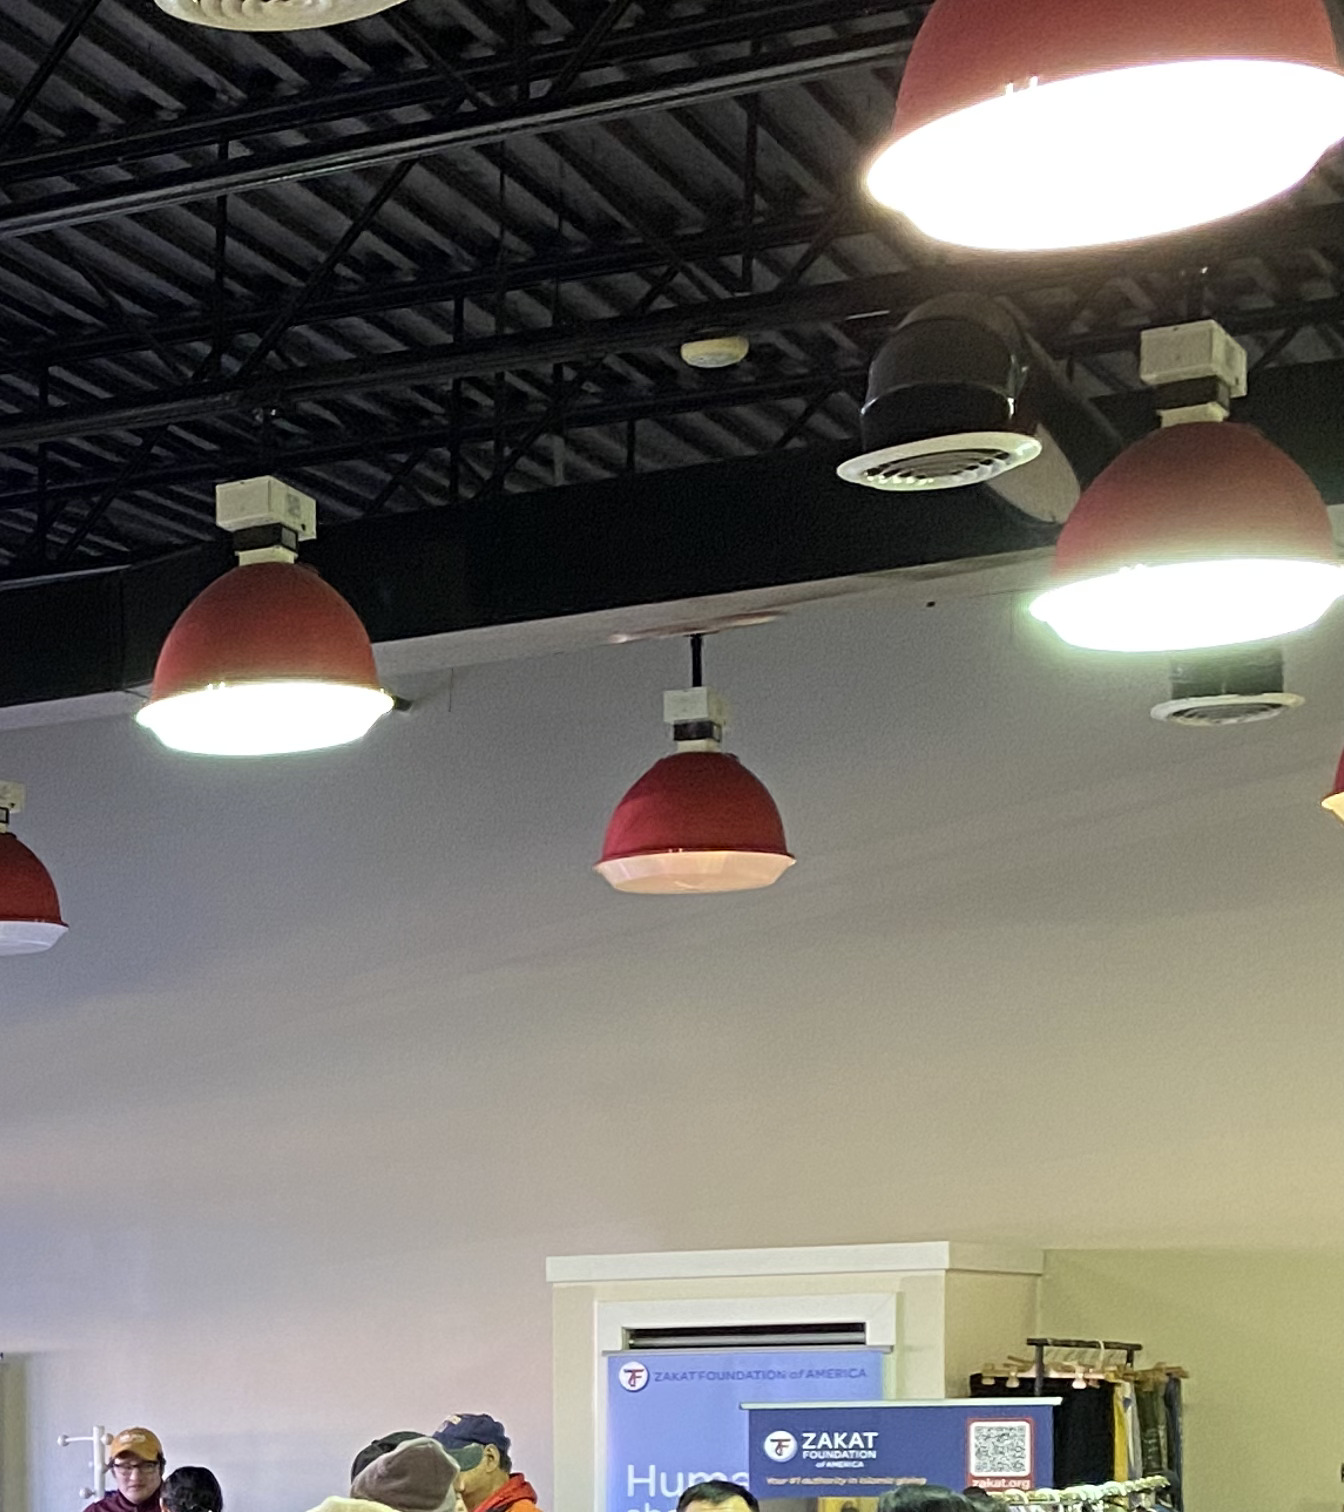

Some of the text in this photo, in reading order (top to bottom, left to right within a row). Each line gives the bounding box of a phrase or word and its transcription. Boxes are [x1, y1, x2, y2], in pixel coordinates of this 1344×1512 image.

[654, 1371, 697, 1382] ZAKAT
[697, 1369, 786, 1382] FOUNDATION
[806, 1367, 868, 1380] AMERICA
[802, 1432, 879, 1450] ZAKAT
[802, 1450, 877, 1460] FOUNDATION
[972, 1478, 1032, 1491] zakat.org
